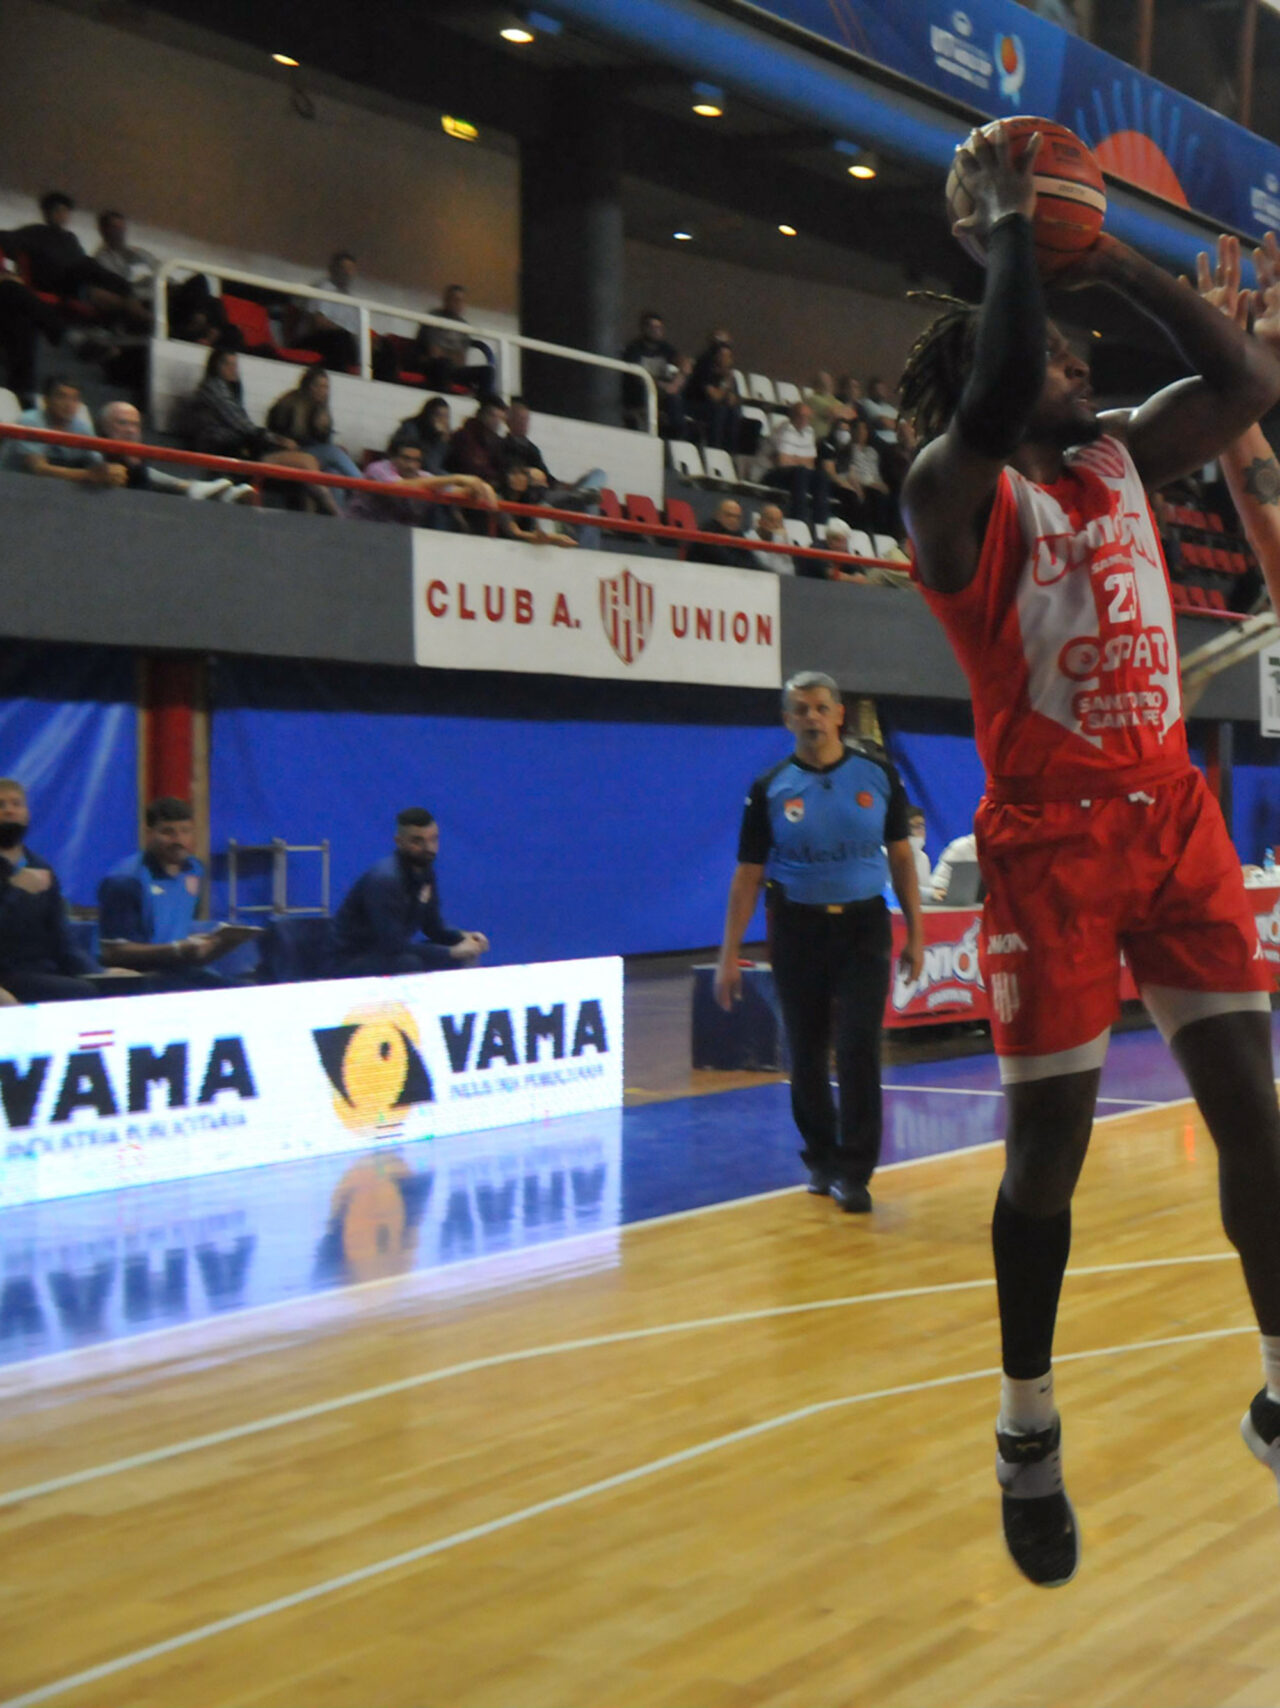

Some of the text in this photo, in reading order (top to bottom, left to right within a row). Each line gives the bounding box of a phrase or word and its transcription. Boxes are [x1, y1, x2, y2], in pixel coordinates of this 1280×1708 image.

[426, 579, 773, 645] CLUB A. UNION
[0, 999, 610, 1130] VAMA VAMA
